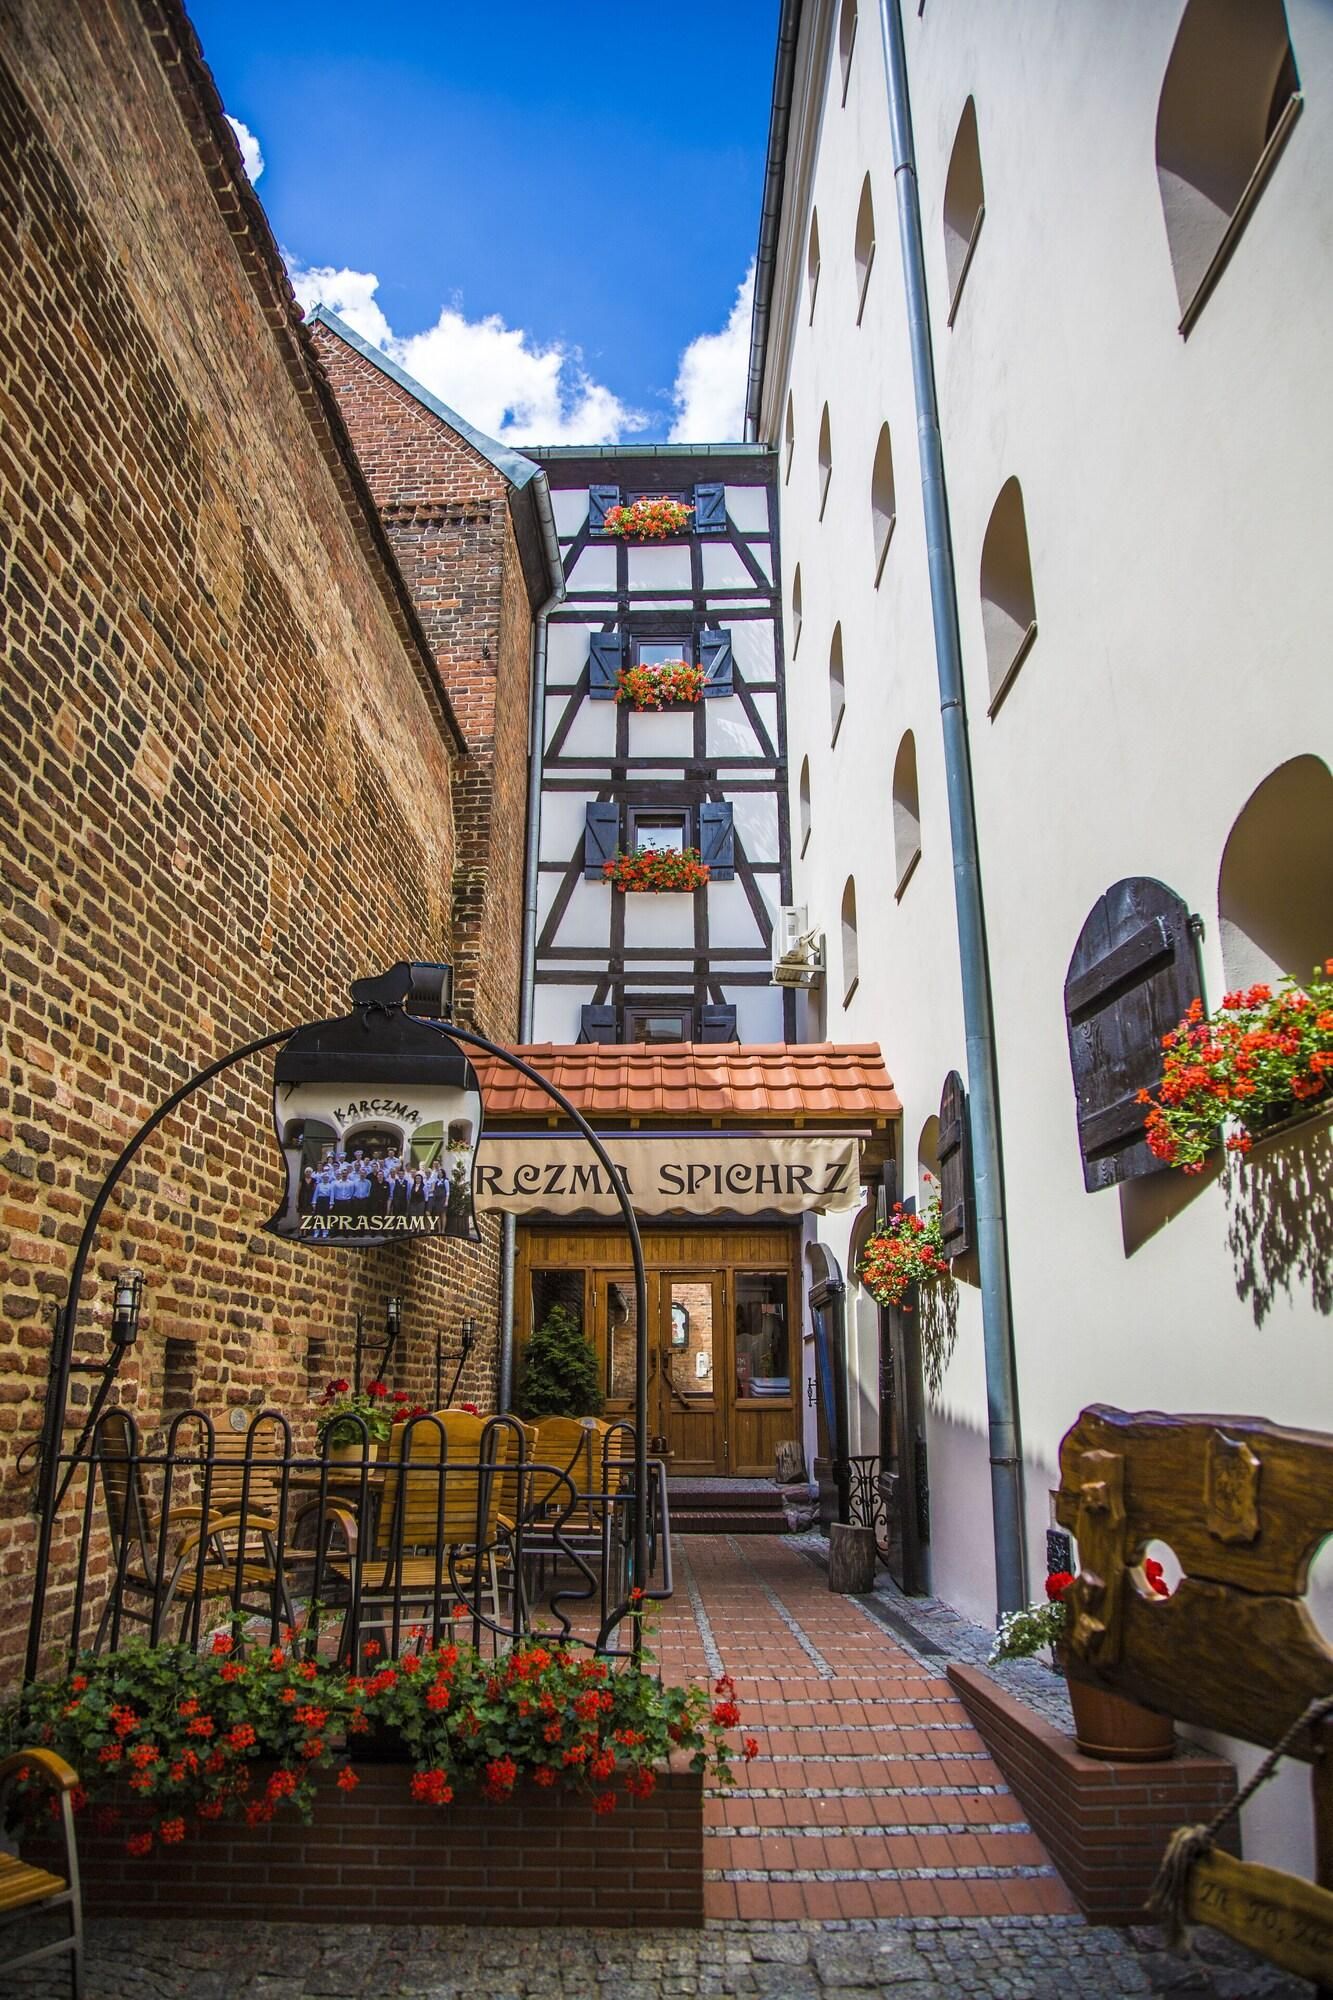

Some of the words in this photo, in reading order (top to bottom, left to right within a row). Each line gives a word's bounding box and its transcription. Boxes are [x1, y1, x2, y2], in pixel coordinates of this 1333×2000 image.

[333, 1099, 420, 1123] KARCZMA
[658, 1164, 848, 1196] SPICHRZ
[301, 1215, 440, 1231] ZAPRASZAMY
